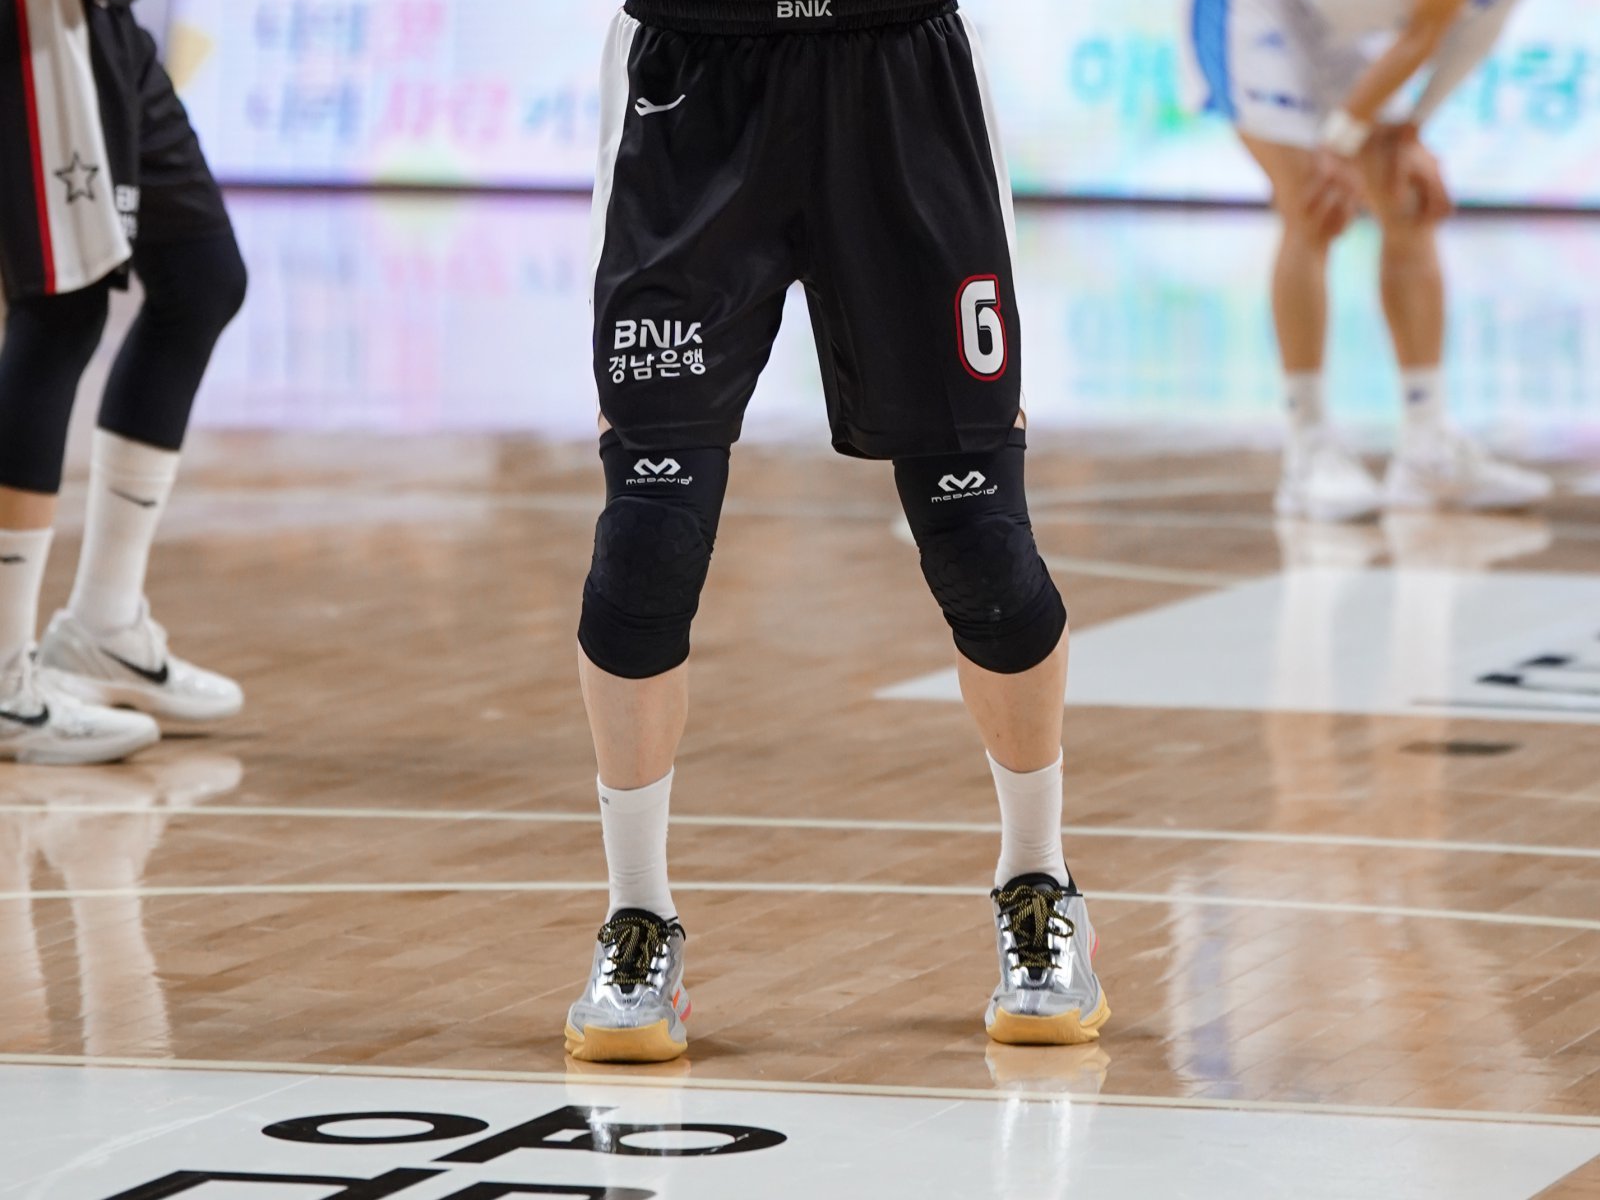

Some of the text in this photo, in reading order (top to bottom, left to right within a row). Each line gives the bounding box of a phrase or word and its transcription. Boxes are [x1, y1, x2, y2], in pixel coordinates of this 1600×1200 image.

[777, 0, 833, 18] BNK
[614, 318, 703, 349] BNK
[955, 274, 1007, 381] 6
[608, 348, 706, 384] 경남은행
